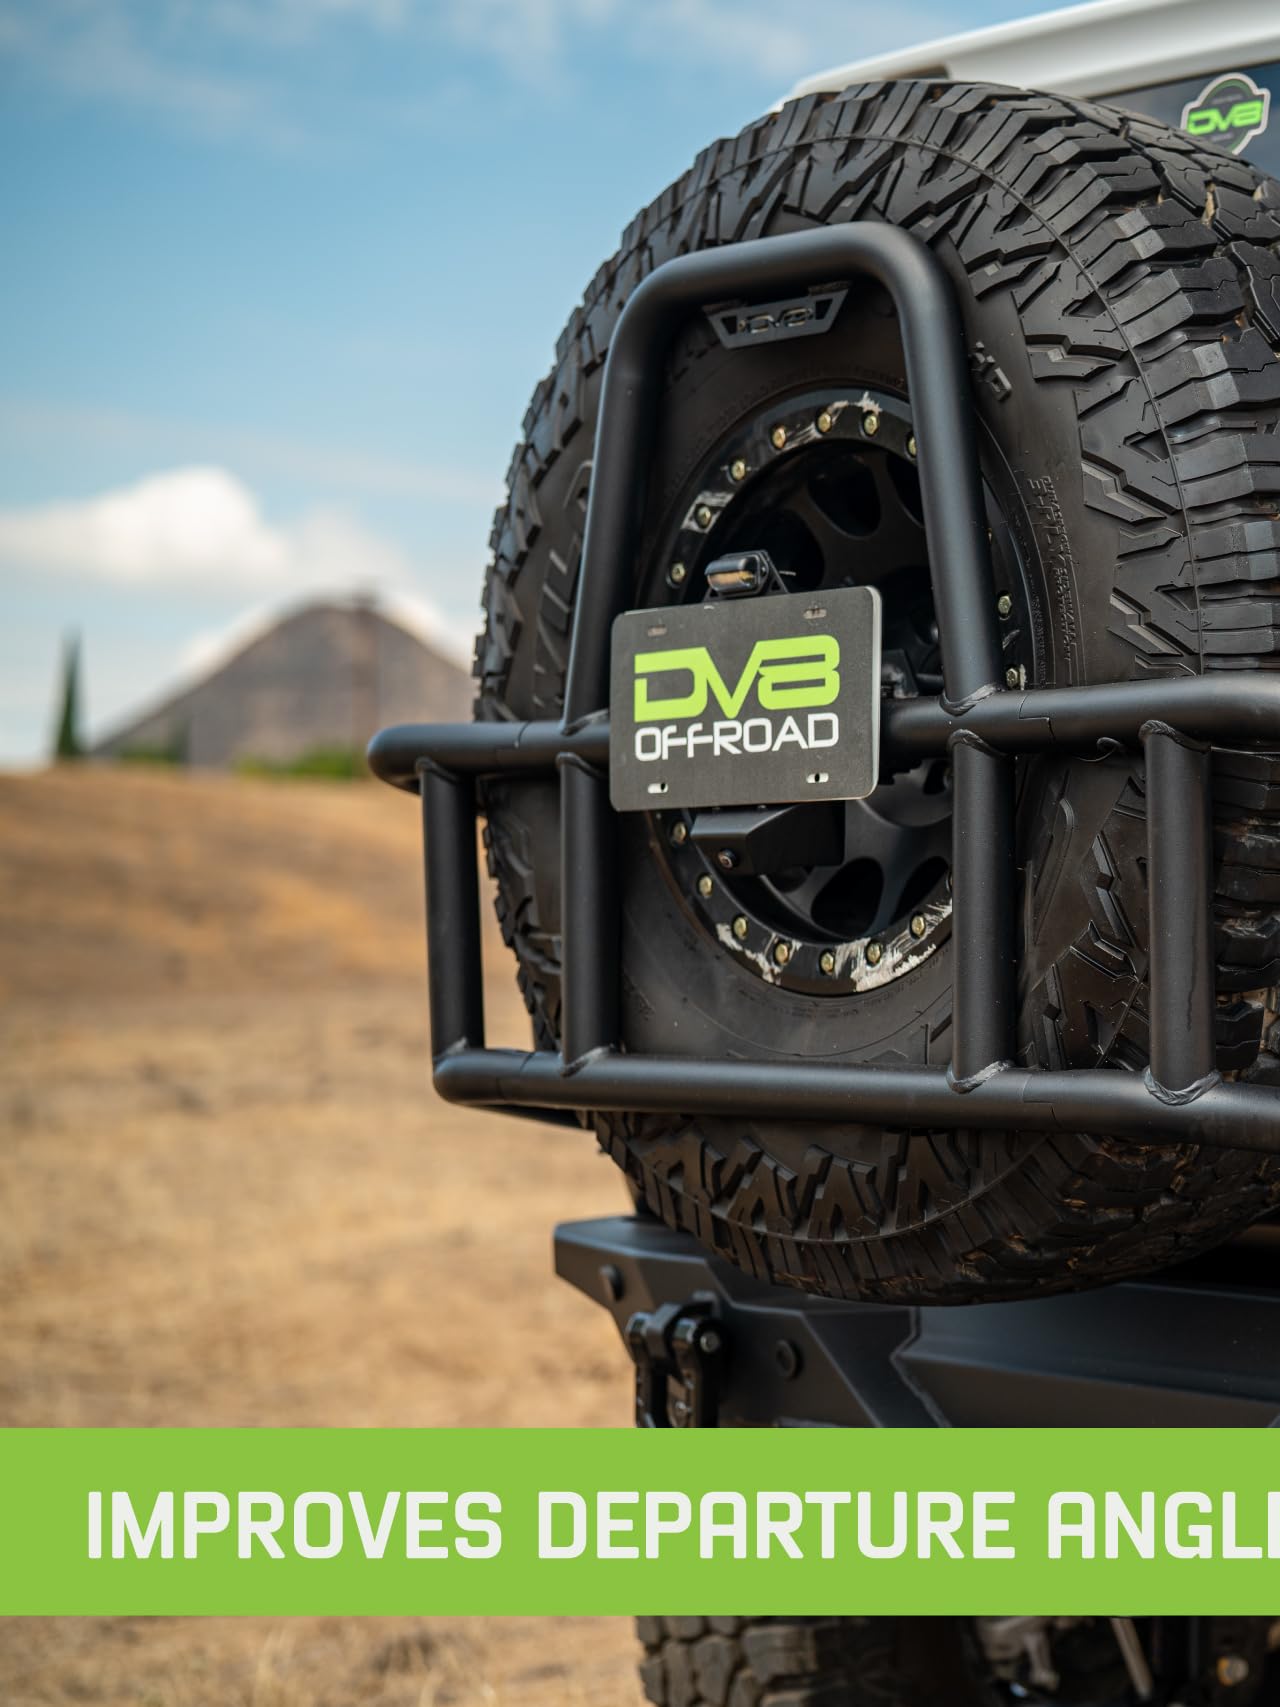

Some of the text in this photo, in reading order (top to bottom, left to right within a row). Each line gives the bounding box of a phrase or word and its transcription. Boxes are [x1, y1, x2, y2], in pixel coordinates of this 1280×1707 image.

[1187, 100, 1264, 136] DV8
[634, 634, 840, 720] DV8
[634, 712, 840, 762] OFFROAD
